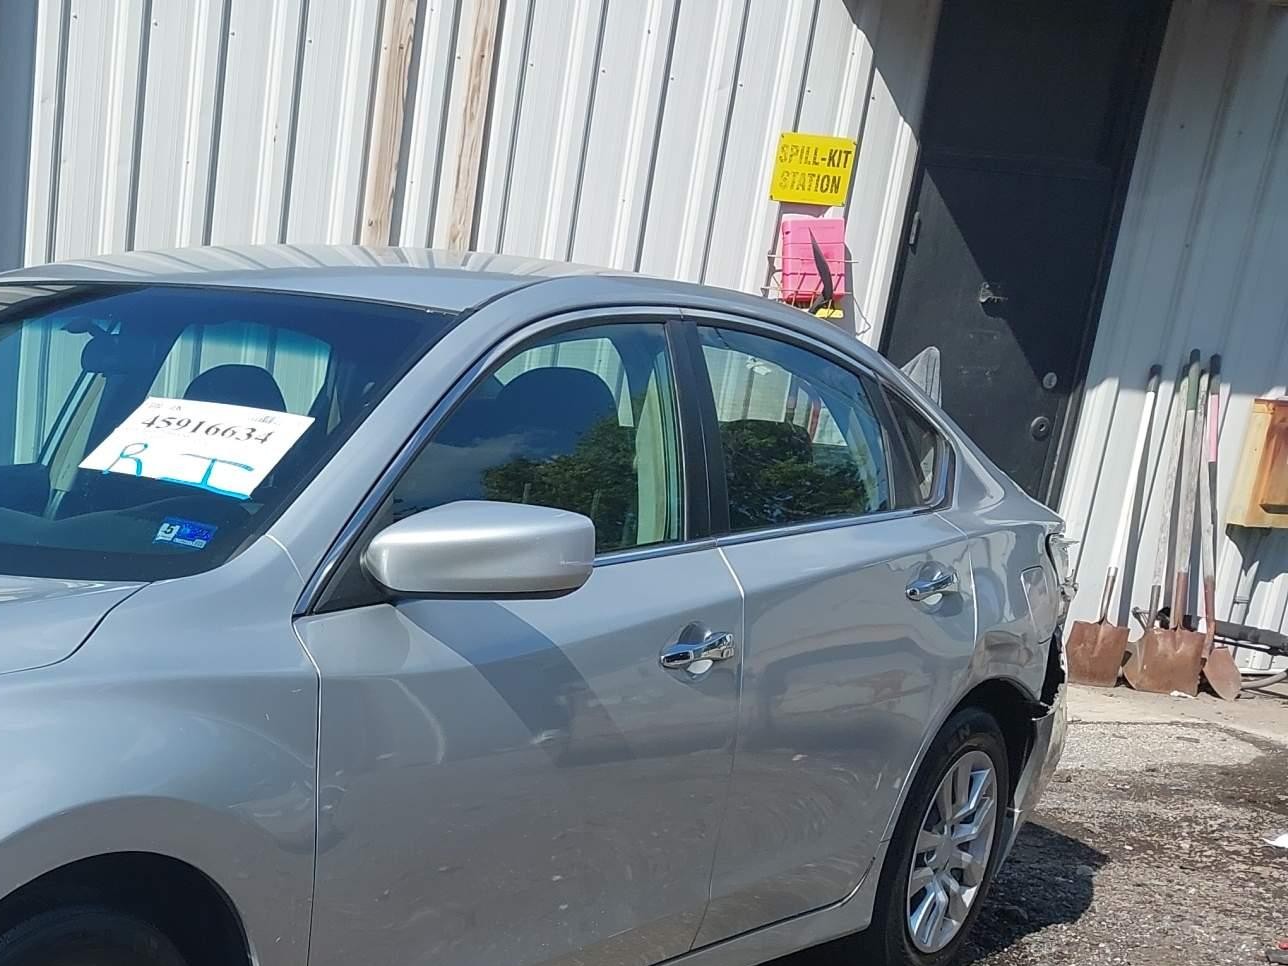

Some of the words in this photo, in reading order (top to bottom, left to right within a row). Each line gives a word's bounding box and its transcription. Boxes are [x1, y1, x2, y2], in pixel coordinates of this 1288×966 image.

[779, 144, 852, 168] SPILL-KIT
[779, 170, 841, 194] STATION
[141, 414, 275, 444] 45916634
